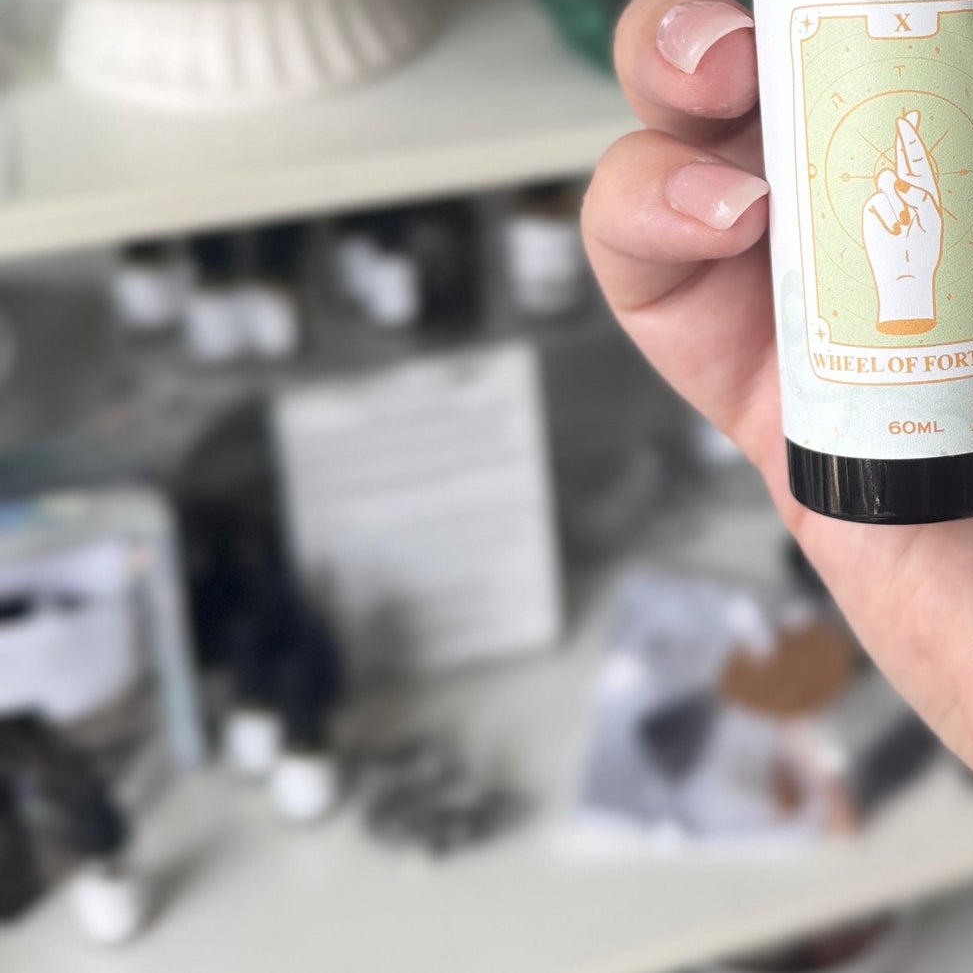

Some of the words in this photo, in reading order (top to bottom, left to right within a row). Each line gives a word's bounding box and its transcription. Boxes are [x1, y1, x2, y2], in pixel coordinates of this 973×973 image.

[813, 353, 885, 373] WHEEL
[887, 356, 919, 374] OF
[888, 420, 945, 435] 60ML
